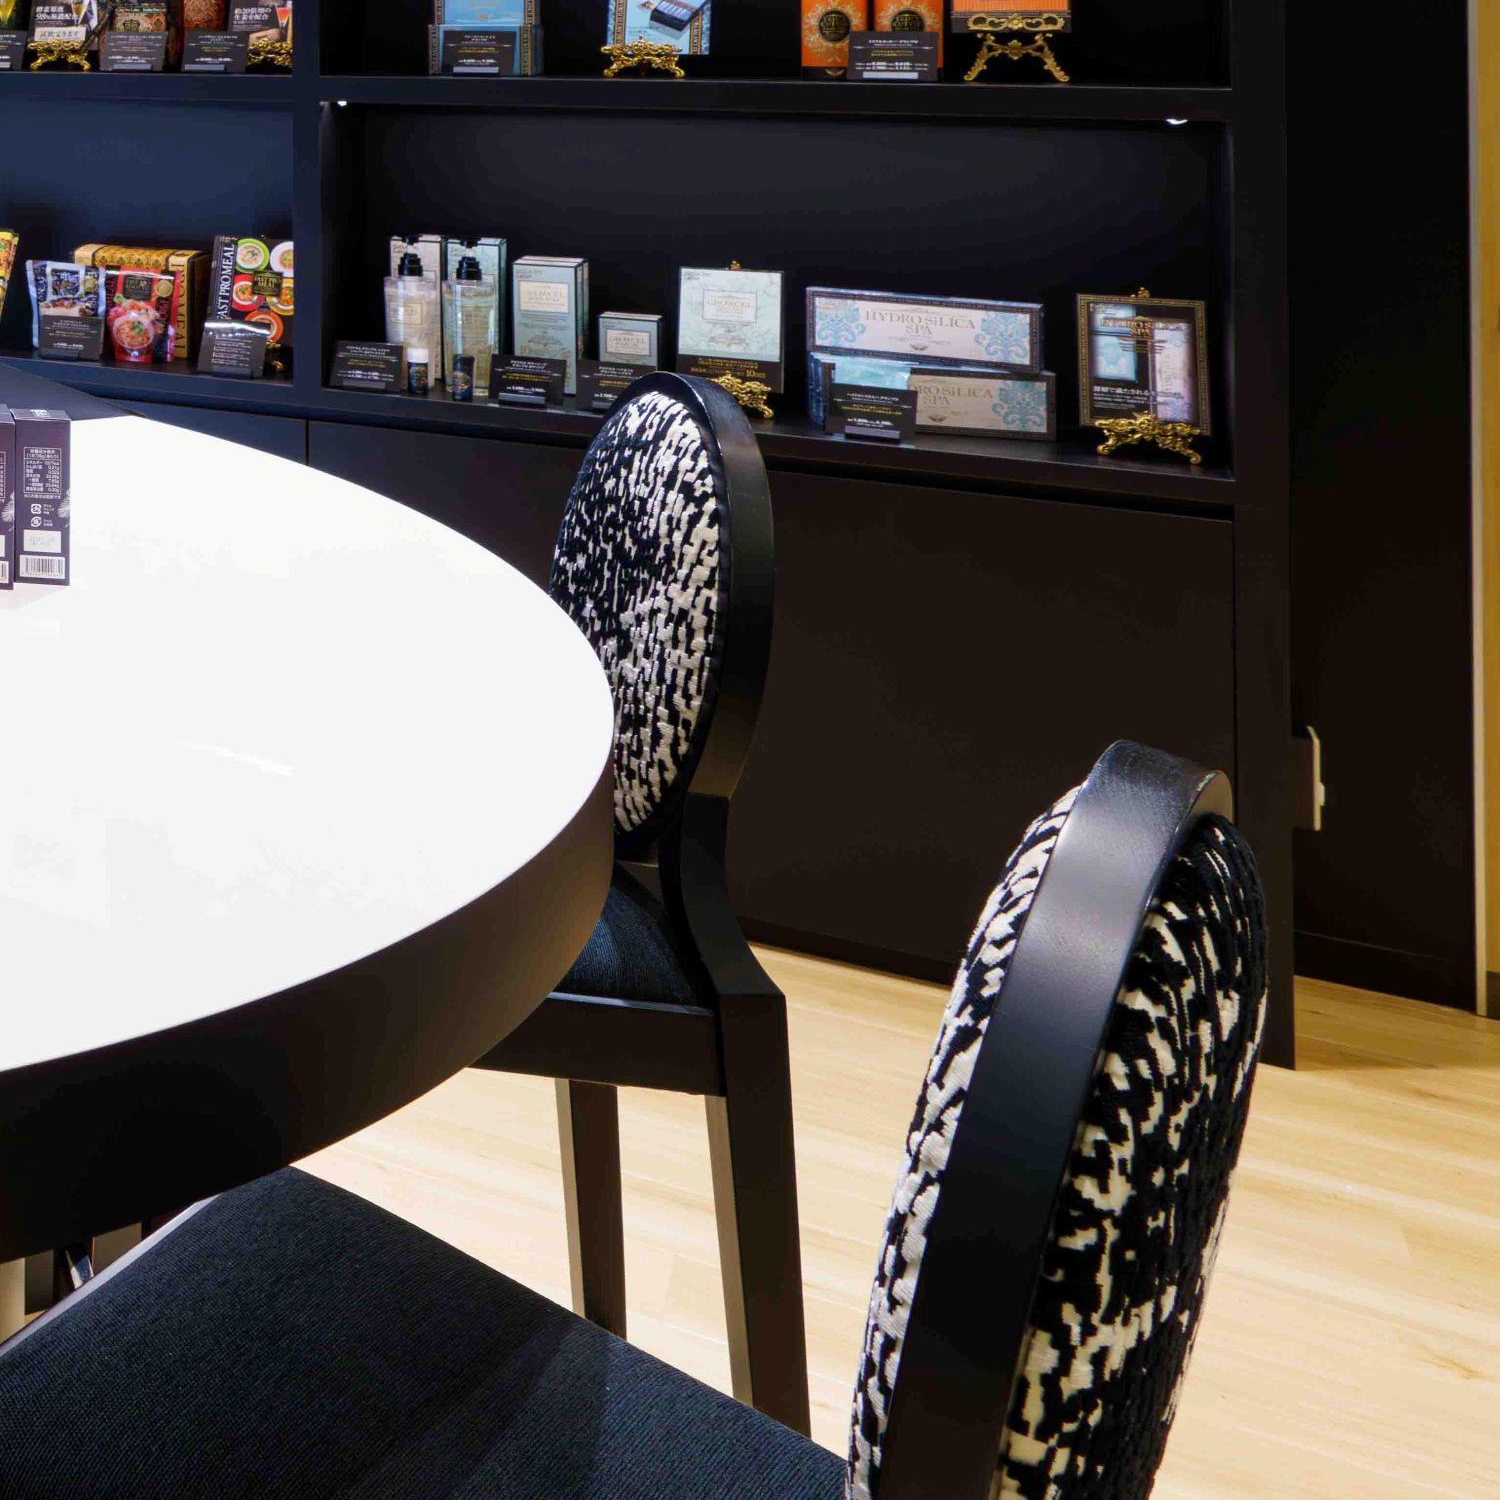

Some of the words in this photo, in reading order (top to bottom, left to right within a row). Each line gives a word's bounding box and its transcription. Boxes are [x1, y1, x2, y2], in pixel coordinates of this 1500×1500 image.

[865, 310, 924, 325] HYDRO
[905, 323, 933, 336] SPA
[922, 396, 952, 406] SPA
